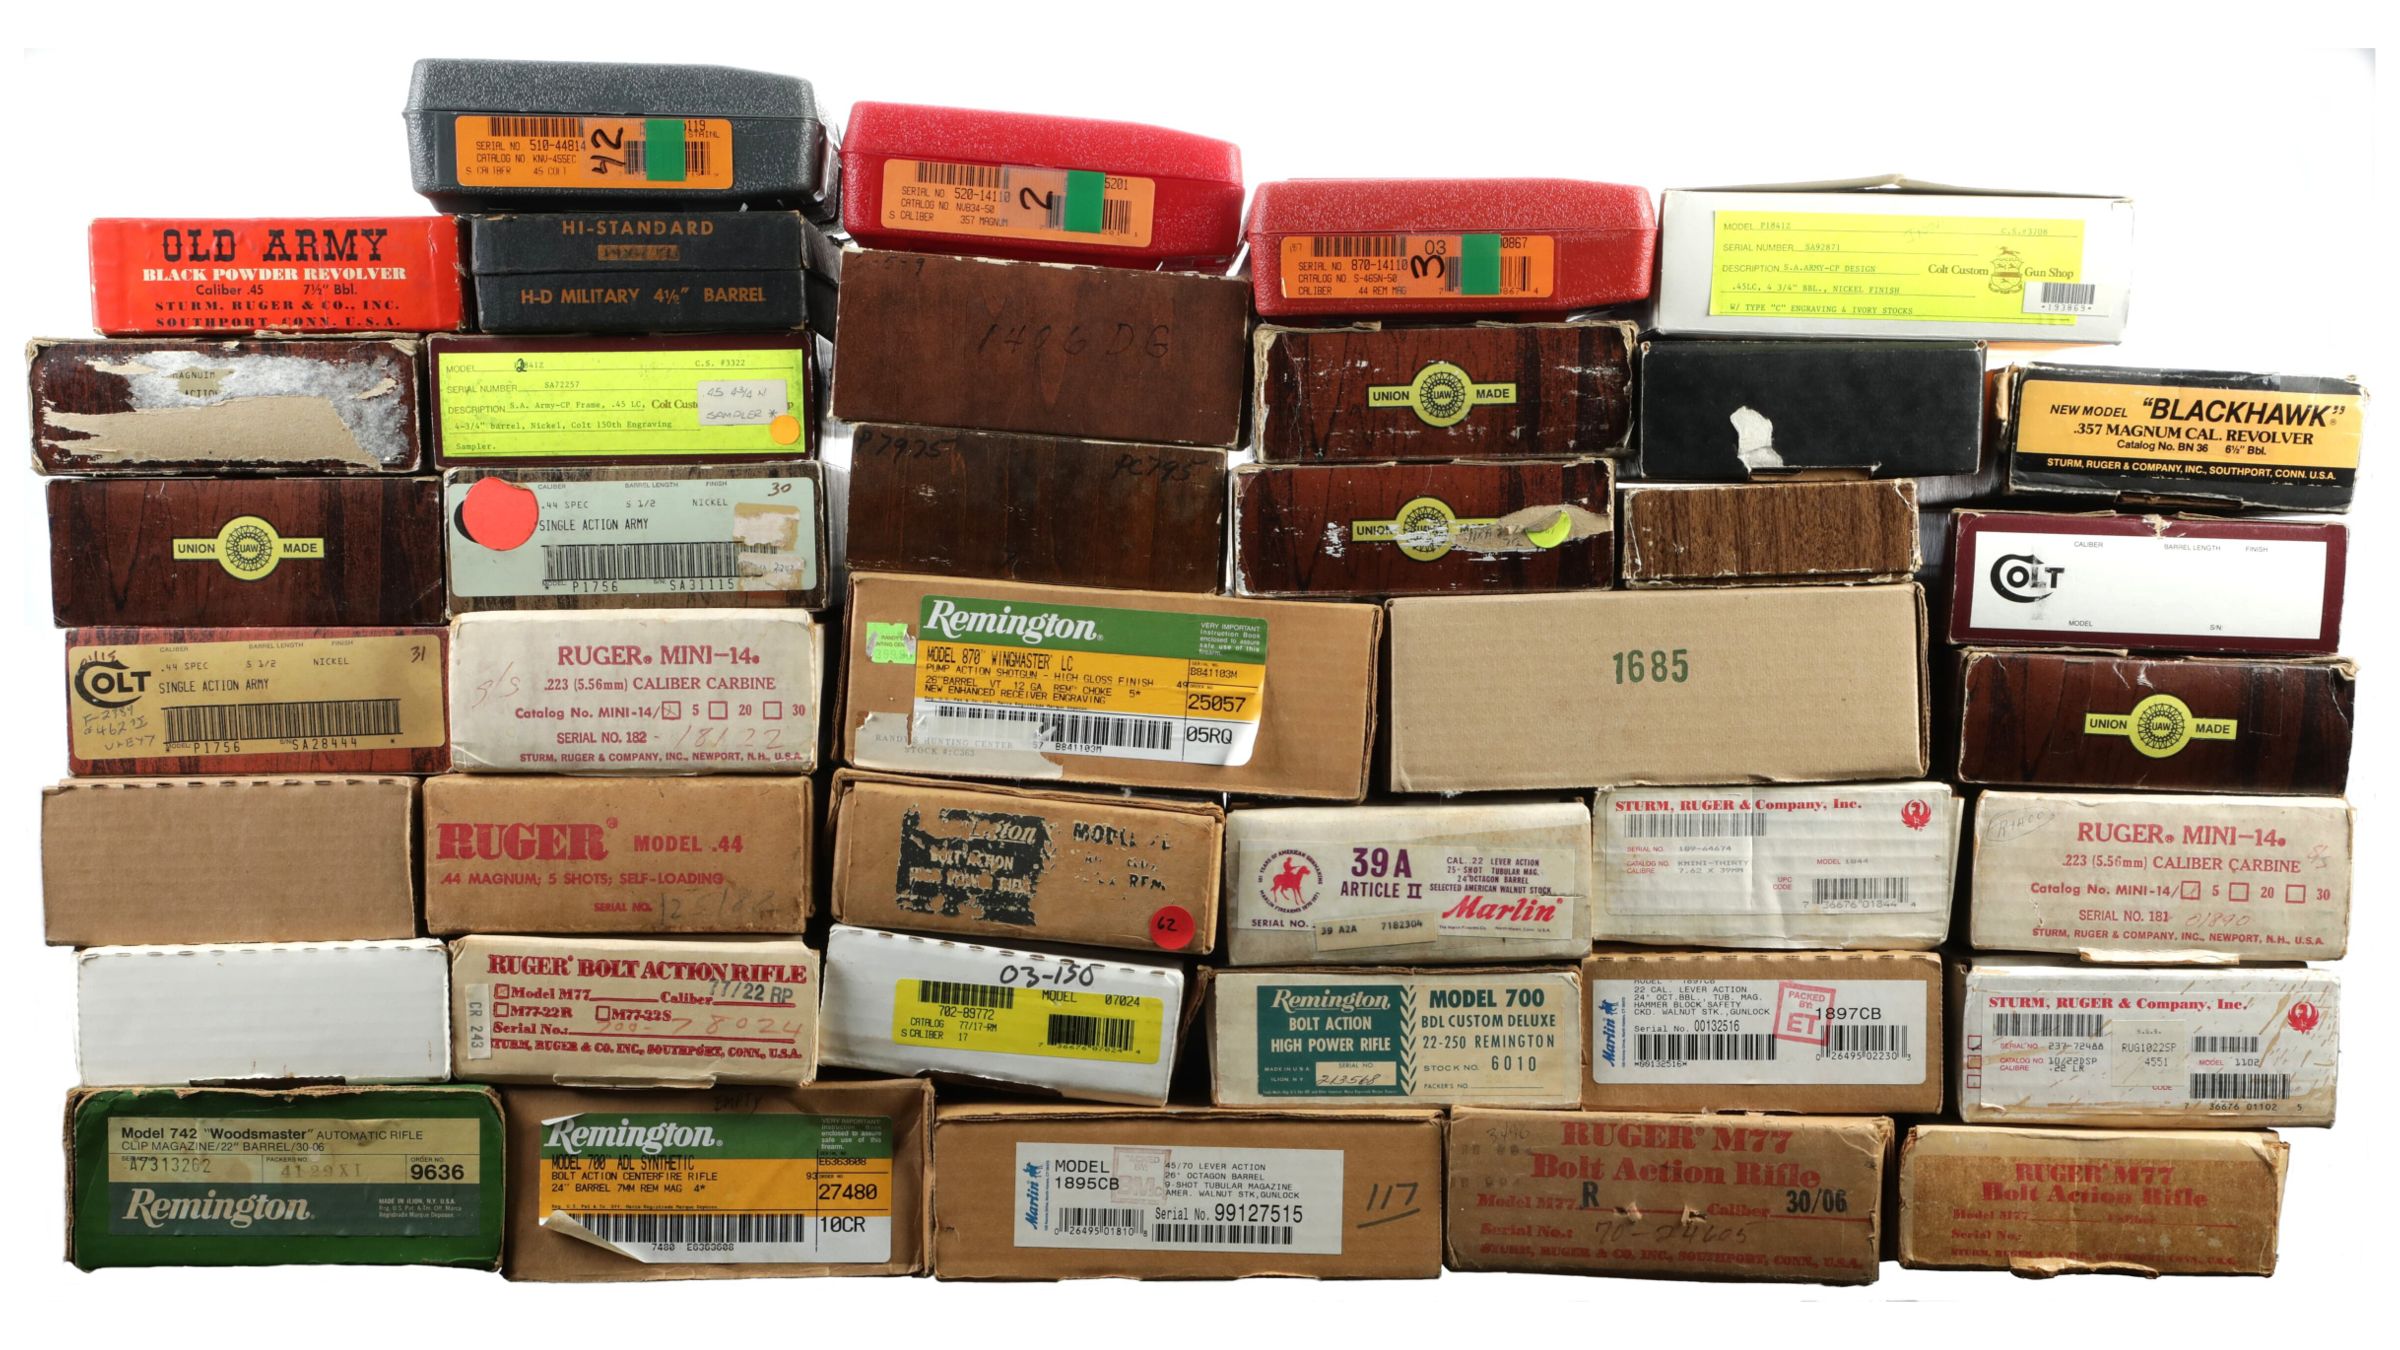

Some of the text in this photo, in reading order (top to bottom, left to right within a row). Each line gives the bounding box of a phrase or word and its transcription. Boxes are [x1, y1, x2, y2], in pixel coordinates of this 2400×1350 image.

[476, 141, 506, 150] SERIAL
[530, 140, 586, 152] 510-44814
[902, 187, 930, 196] SERIAL
[934, 189, 944, 198] NO
[563, 221, 713, 235] HI-STANDARD
[163, 229, 387, 262] OLD ARMY
[1298, 259, 1408, 271] SERIAL NO 870-14110
[1928, 265, 1989, 276] Colt Custom
[143, 268, 406, 281] BLACK POWDER REVOLVER
[2024, 267, 2074, 280] Gun Shop
[522, 288, 766, 304] H-D MILITARY BARREL
[447, 381, 580, 393] SERIAL NUMBER SA72257
[1373, 388, 1509, 401] UNION UAW MADE
[2050, 404, 2080, 415] NEW
[2082, 405, 2128, 417] MODEL
[2074, 423, 2313, 445] .357 MAGNUM CAL. REVOLVER
[2117, 440, 2208, 452] Catalog No. BN 36
[768, 482, 792, 496] 30
[540, 518, 648, 531] SINGLE ACTION ARMY
[178, 543, 317, 553] UNION UAW MADE
[1990, 553, 2064, 603] COLT
[924, 599, 1096, 644] Remington
[411, 646, 426, 662] 31
[927, 646, 956, 663] MODEL
[992, 651, 1050, 669] WINGMASTER
[1613, 649, 1688, 684] 1685
[75, 661, 151, 708] COLT
[159, 679, 269, 694] SINGLE ACTION ARMY
[545, 677, 775, 693] .223 (5.56mm) CALIBER CARBINE
[1188, 694, 1246, 713] 25057
[2090, 718, 2231, 735] UNION UAW MADE
[1187, 727, 1232, 744] 05RQ
[1615, 799, 1861, 812] STURM, RUGER & Company, Inc.
[437, 823, 743, 860] RUGER MODEL .44
[440, 873, 724, 886] .44 MAGNUM; 5 SHOTS; SELF-LOADING
[1340, 881, 1422, 899] ARTICLE II
[1442, 895, 1557, 922] Marlin
[1157, 918, 1178, 932] 62
[487, 954, 806, 984] RUGER BOLT ACTION RIFLE
[511, 987, 713, 1004] Model M77 Caliber
[1042, 990, 1140, 1007] MODEL 07024
[1271, 988, 1391, 1013] Remington
[1429, 989, 1544, 1008] MODEL 700
[939, 1005, 994, 1020] 702-89772
[1989, 997, 2247, 1012] STURM, RUGER & Company, Inc.
[1422, 1014, 1556, 1027] BDL CUSTOM DELUXE
[1816, 1007, 1881, 1020] 1897CB
[1289, 1017, 1371, 1030] BOLT ACTION
[1695, 1019, 1739, 1032] 00132516
[1271, 1038, 1391, 1052] HIGH POWER RIFLE
[1423, 1035, 1555, 1050] 22-250 REMINGTON
[1491, 1056, 1537, 1071] 6010
[121, 1128, 314, 1140] Model 742 "Woodsmaster"
[544, 1118, 716, 1154] Remington
[1560, 1121, 1792, 1153] RUGER M77
[552, 1155, 581, 1171] MODEL
[617, 1154, 635, 1169] ADL
[641, 1154, 695, 1170] SYNTHETIC
[1055, 1159, 1110, 1174] MODEL
[1531, 1152, 1604, 1179] Bolt
[1612, 1158, 1725, 1185] Action
[1735, 1163, 1821, 1188] Rifle
[410, 1164, 464, 1180] 9636
[2114, 1166, 2175, 1185] M77
[1055, 1176, 1119, 1190] 1895CB
[818, 1184, 877, 1200] 27480
[123, 1188, 311, 1227] Remington
[1025, 1181, 1040, 1229] Marlin
[1786, 1190, 1847, 1213] 30/06
[1155, 1204, 1303, 1224] Serial No. 99127515
[820, 1216, 865, 1233] 10CR
